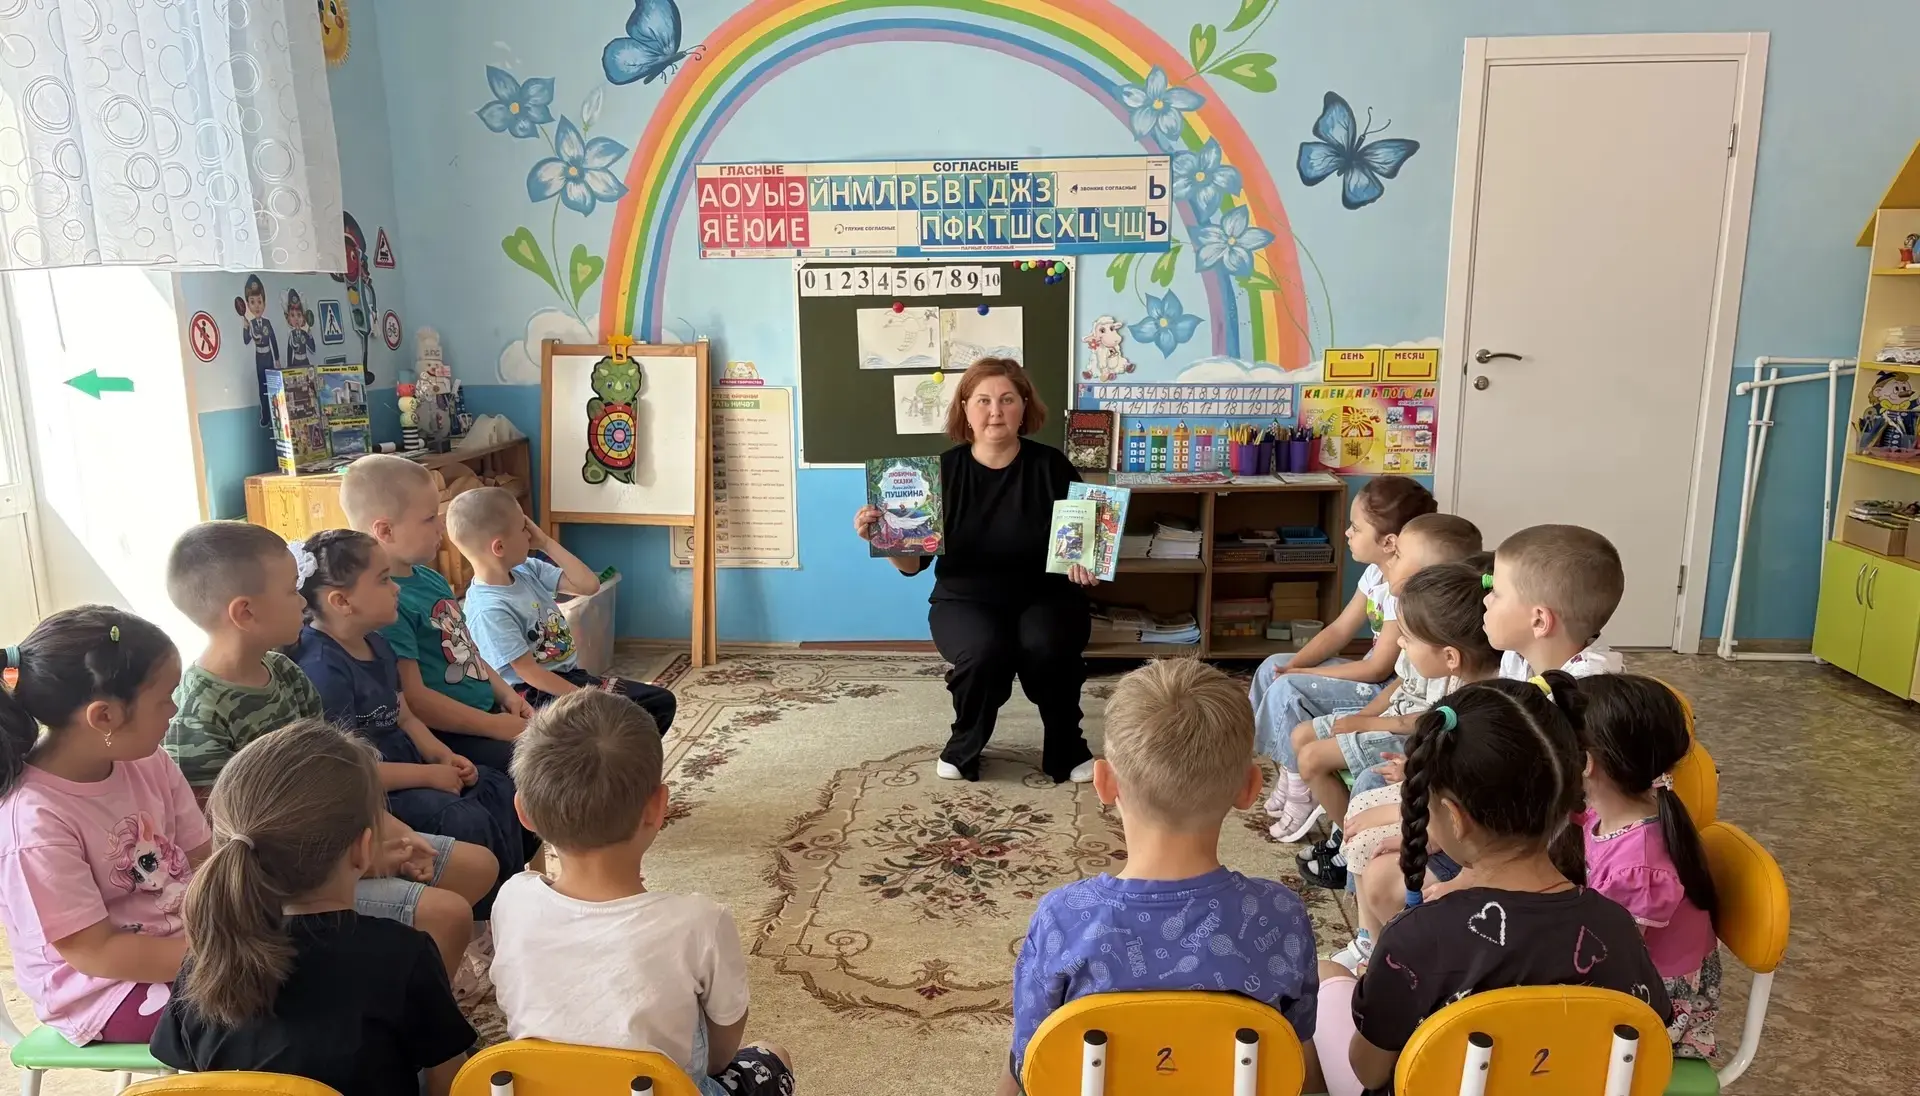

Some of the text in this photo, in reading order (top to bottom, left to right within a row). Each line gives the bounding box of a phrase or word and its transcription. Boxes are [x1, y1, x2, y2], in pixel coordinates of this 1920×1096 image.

[719, 165, 785, 176] ГЛАСНЫЕ
[932, 160, 1019, 172] СОГЛАСНЫЕ
[804, 269, 1000, 291] 0 1 2 3 4 5 6 7 8 9 10
[1340, 352, 1365, 360] ДЕНЬ
[1394, 352, 1425, 360] МЕСЯЦ
[1225, 386, 1238, 400] 10
[1249, 386, 1261, 400] 11
[1274, 386, 1286, 400] 12
[1304, 387, 1435, 400] КАЛЕНДАРЬ ПОГОДЫ
[1128, 402, 1143, 414] 14
[1153, 402, 1165, 414] 15
[1176, 402, 1189, 414] 16
[1200, 402, 1212, 414] 17
[1224, 402, 1237, 414] 18
[1248, 402, 1262, 414] 19
[1271, 402, 1285, 414] 20
[885, 490, 924, 498] ПУШКИНА
[1180, 912, 1222, 953] SPORT
[1126, 936, 1147, 978] TENNIS
[1156, 1047, 1179, 1072] 2
[1530, 1048, 1551, 1076] 2
